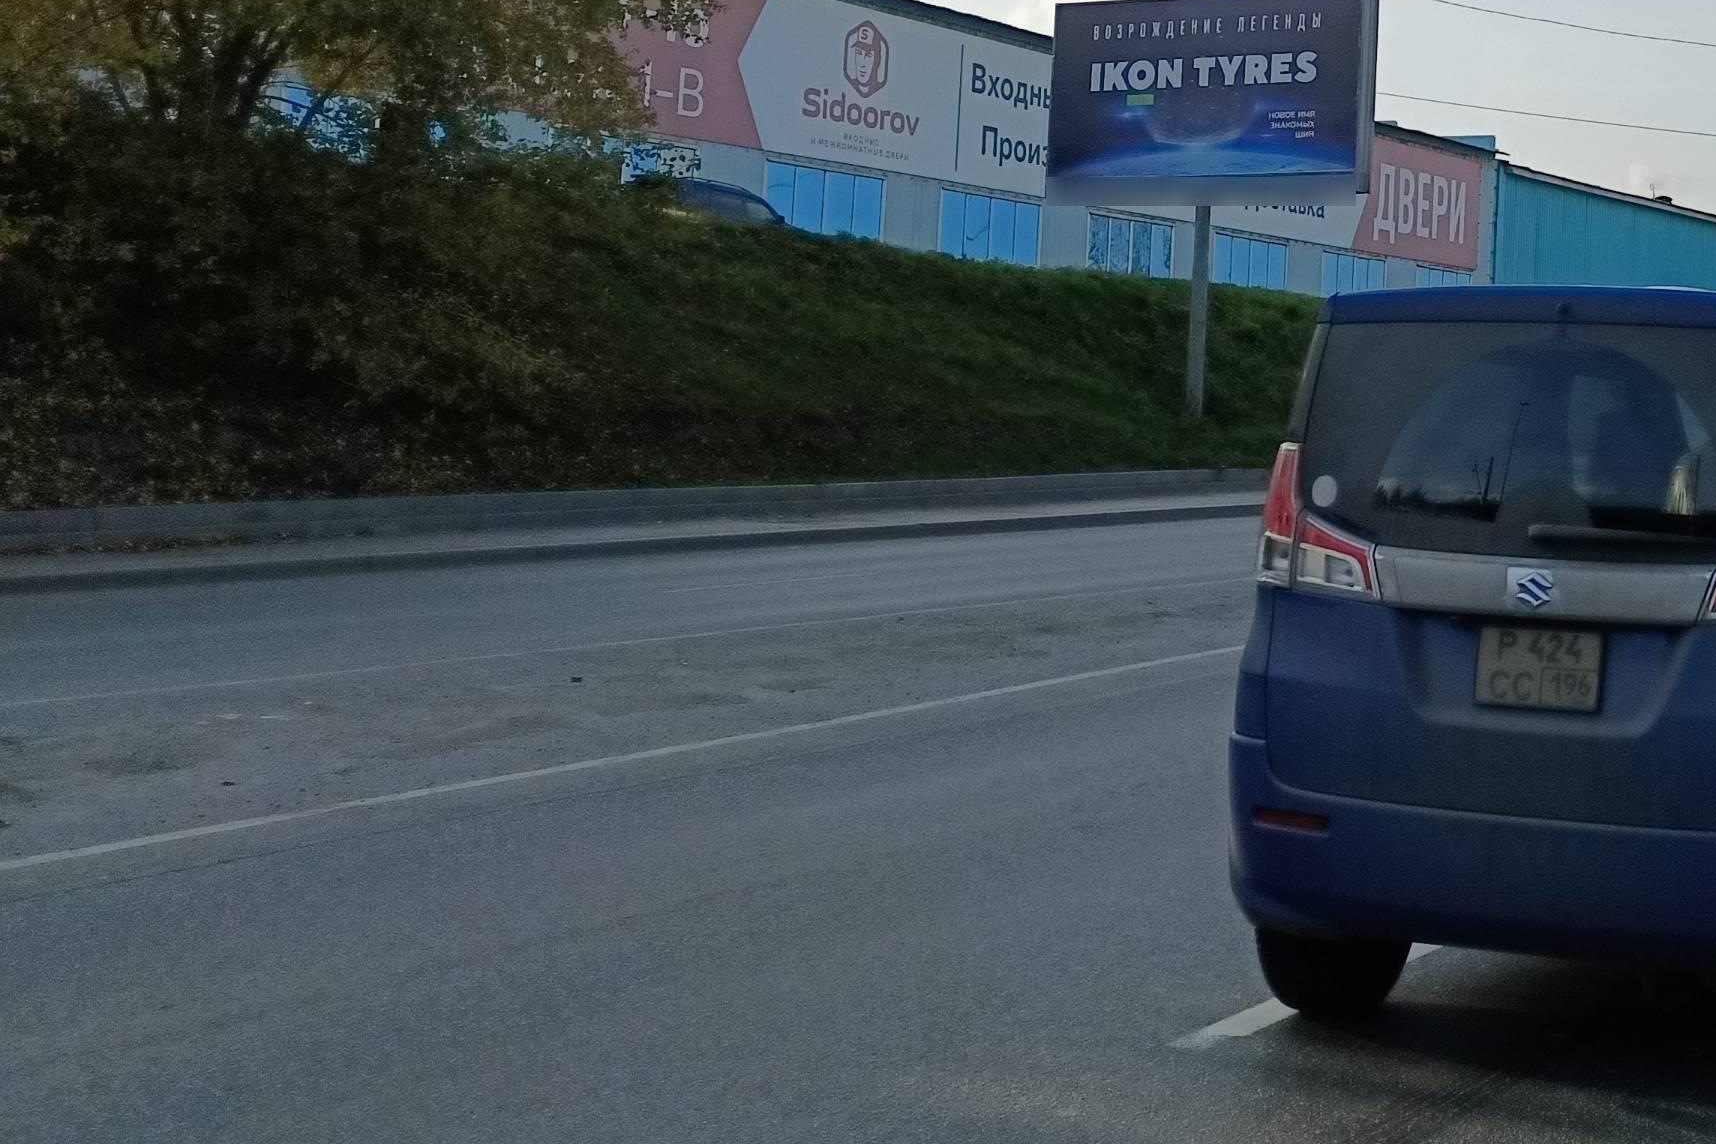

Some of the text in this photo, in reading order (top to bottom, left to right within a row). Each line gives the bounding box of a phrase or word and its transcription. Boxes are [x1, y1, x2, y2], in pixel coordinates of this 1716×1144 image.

[1092, 12, 1322, 41] ВОЗРОЖДЕНИЕ ЛЕГЕНДЫ
[1090, 51, 1318, 92] IKON TYRES
[802, 87, 920, 136] Sidoorov
[1270, 120, 1315, 129] ЗНАКОМЫХ
[1373, 163, 1467, 245] ДВЕРИ
[1528, 632, 1582, 664] 424
[1489, 670, 1533, 701] СС
